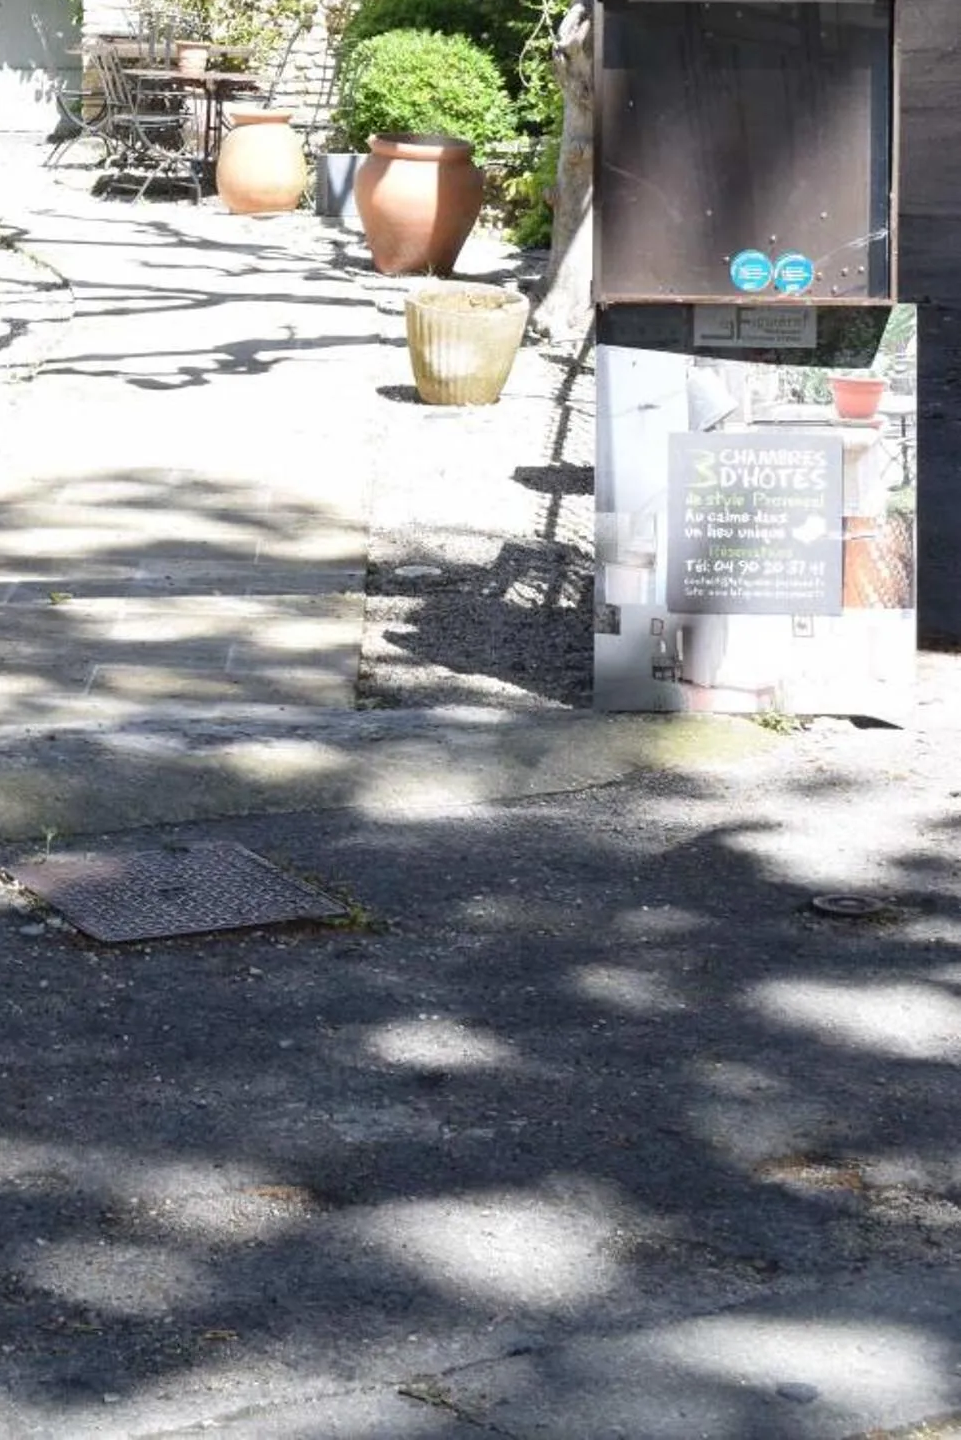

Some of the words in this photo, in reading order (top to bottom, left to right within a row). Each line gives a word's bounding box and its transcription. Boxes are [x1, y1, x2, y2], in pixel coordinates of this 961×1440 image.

[719, 448, 827, 466] CHAMBRES
[685, 508, 704, 523] Au
[707, 507, 750, 523] calme
[684, 527, 703, 539] un
[713, 560, 734, 574] 04
[737, 560, 760, 576] 90
